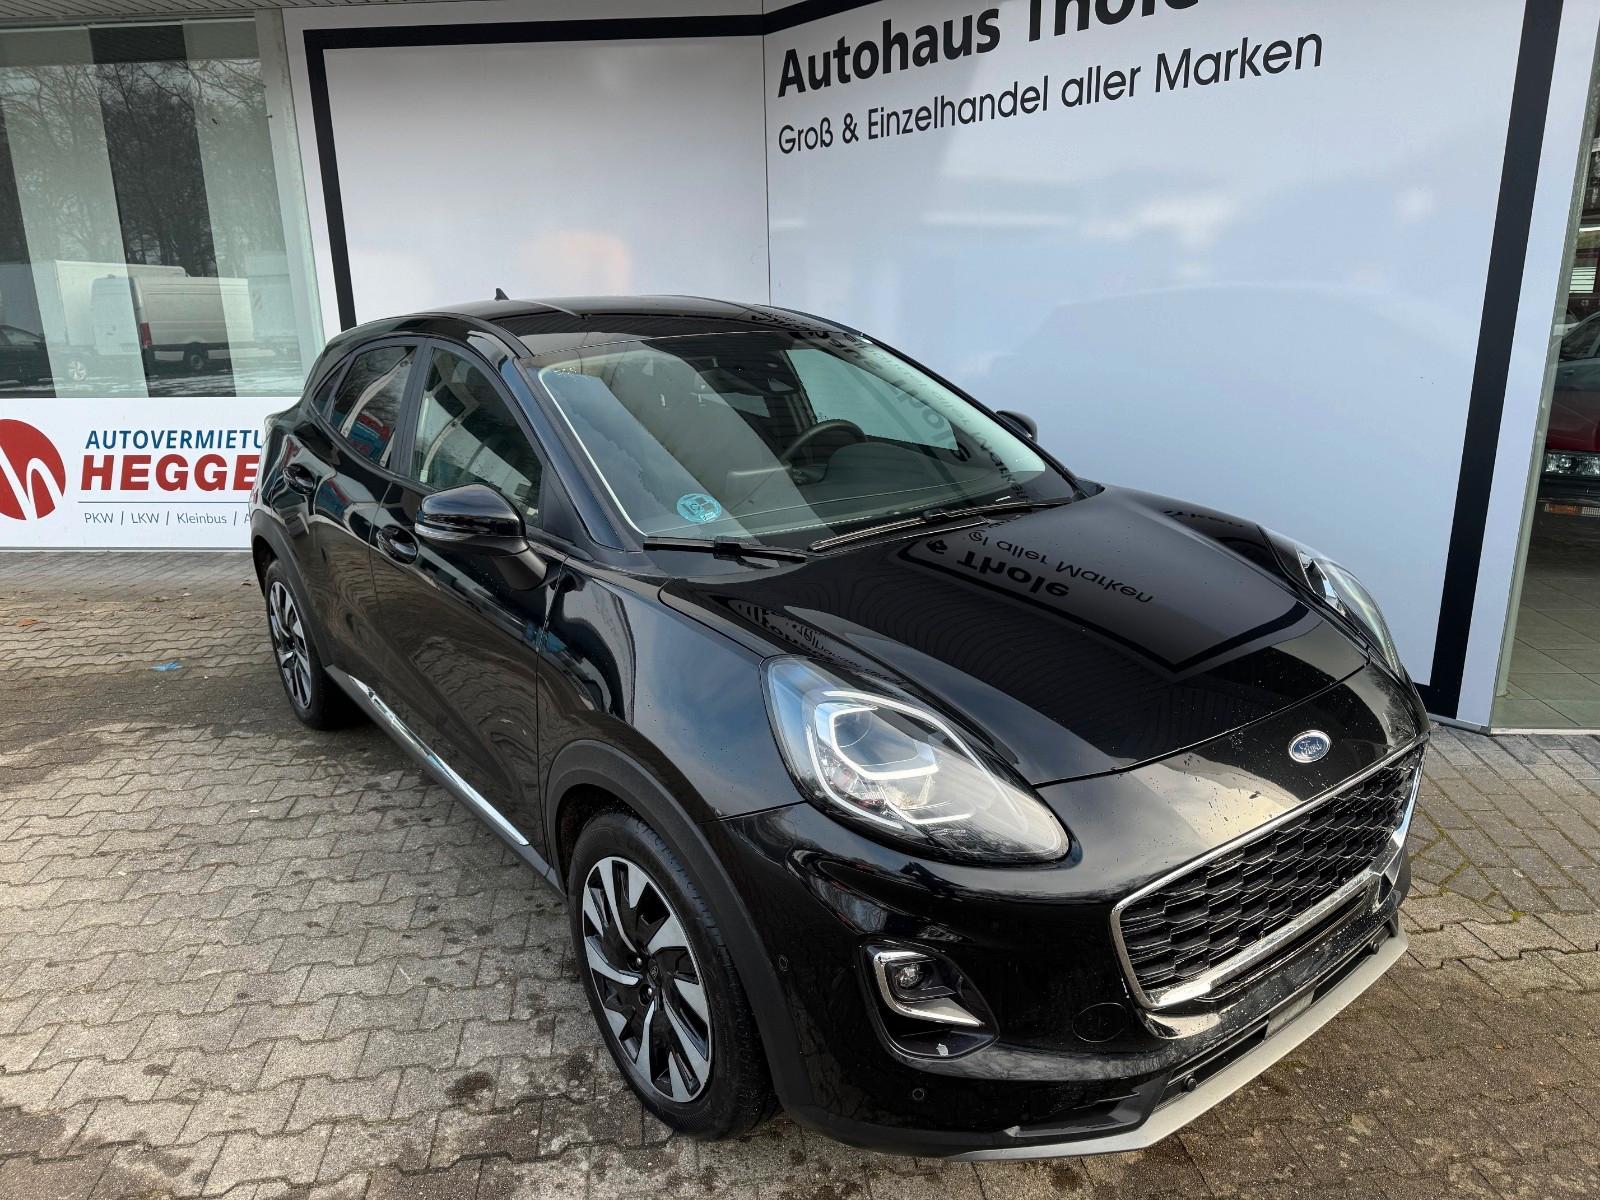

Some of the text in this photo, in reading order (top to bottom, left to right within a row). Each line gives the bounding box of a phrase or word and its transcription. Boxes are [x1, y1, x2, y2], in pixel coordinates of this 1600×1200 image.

[777, 8, 1001, 99] Autohaus
[778, 33, 1324, 155] Groß & Einzelhandel aller Marken
[80, 453, 261, 492] HEGGE
[84, 512, 114, 524] PKW
[131, 512, 160, 524] LKW
[176, 511, 228, 524] Kleinbus
